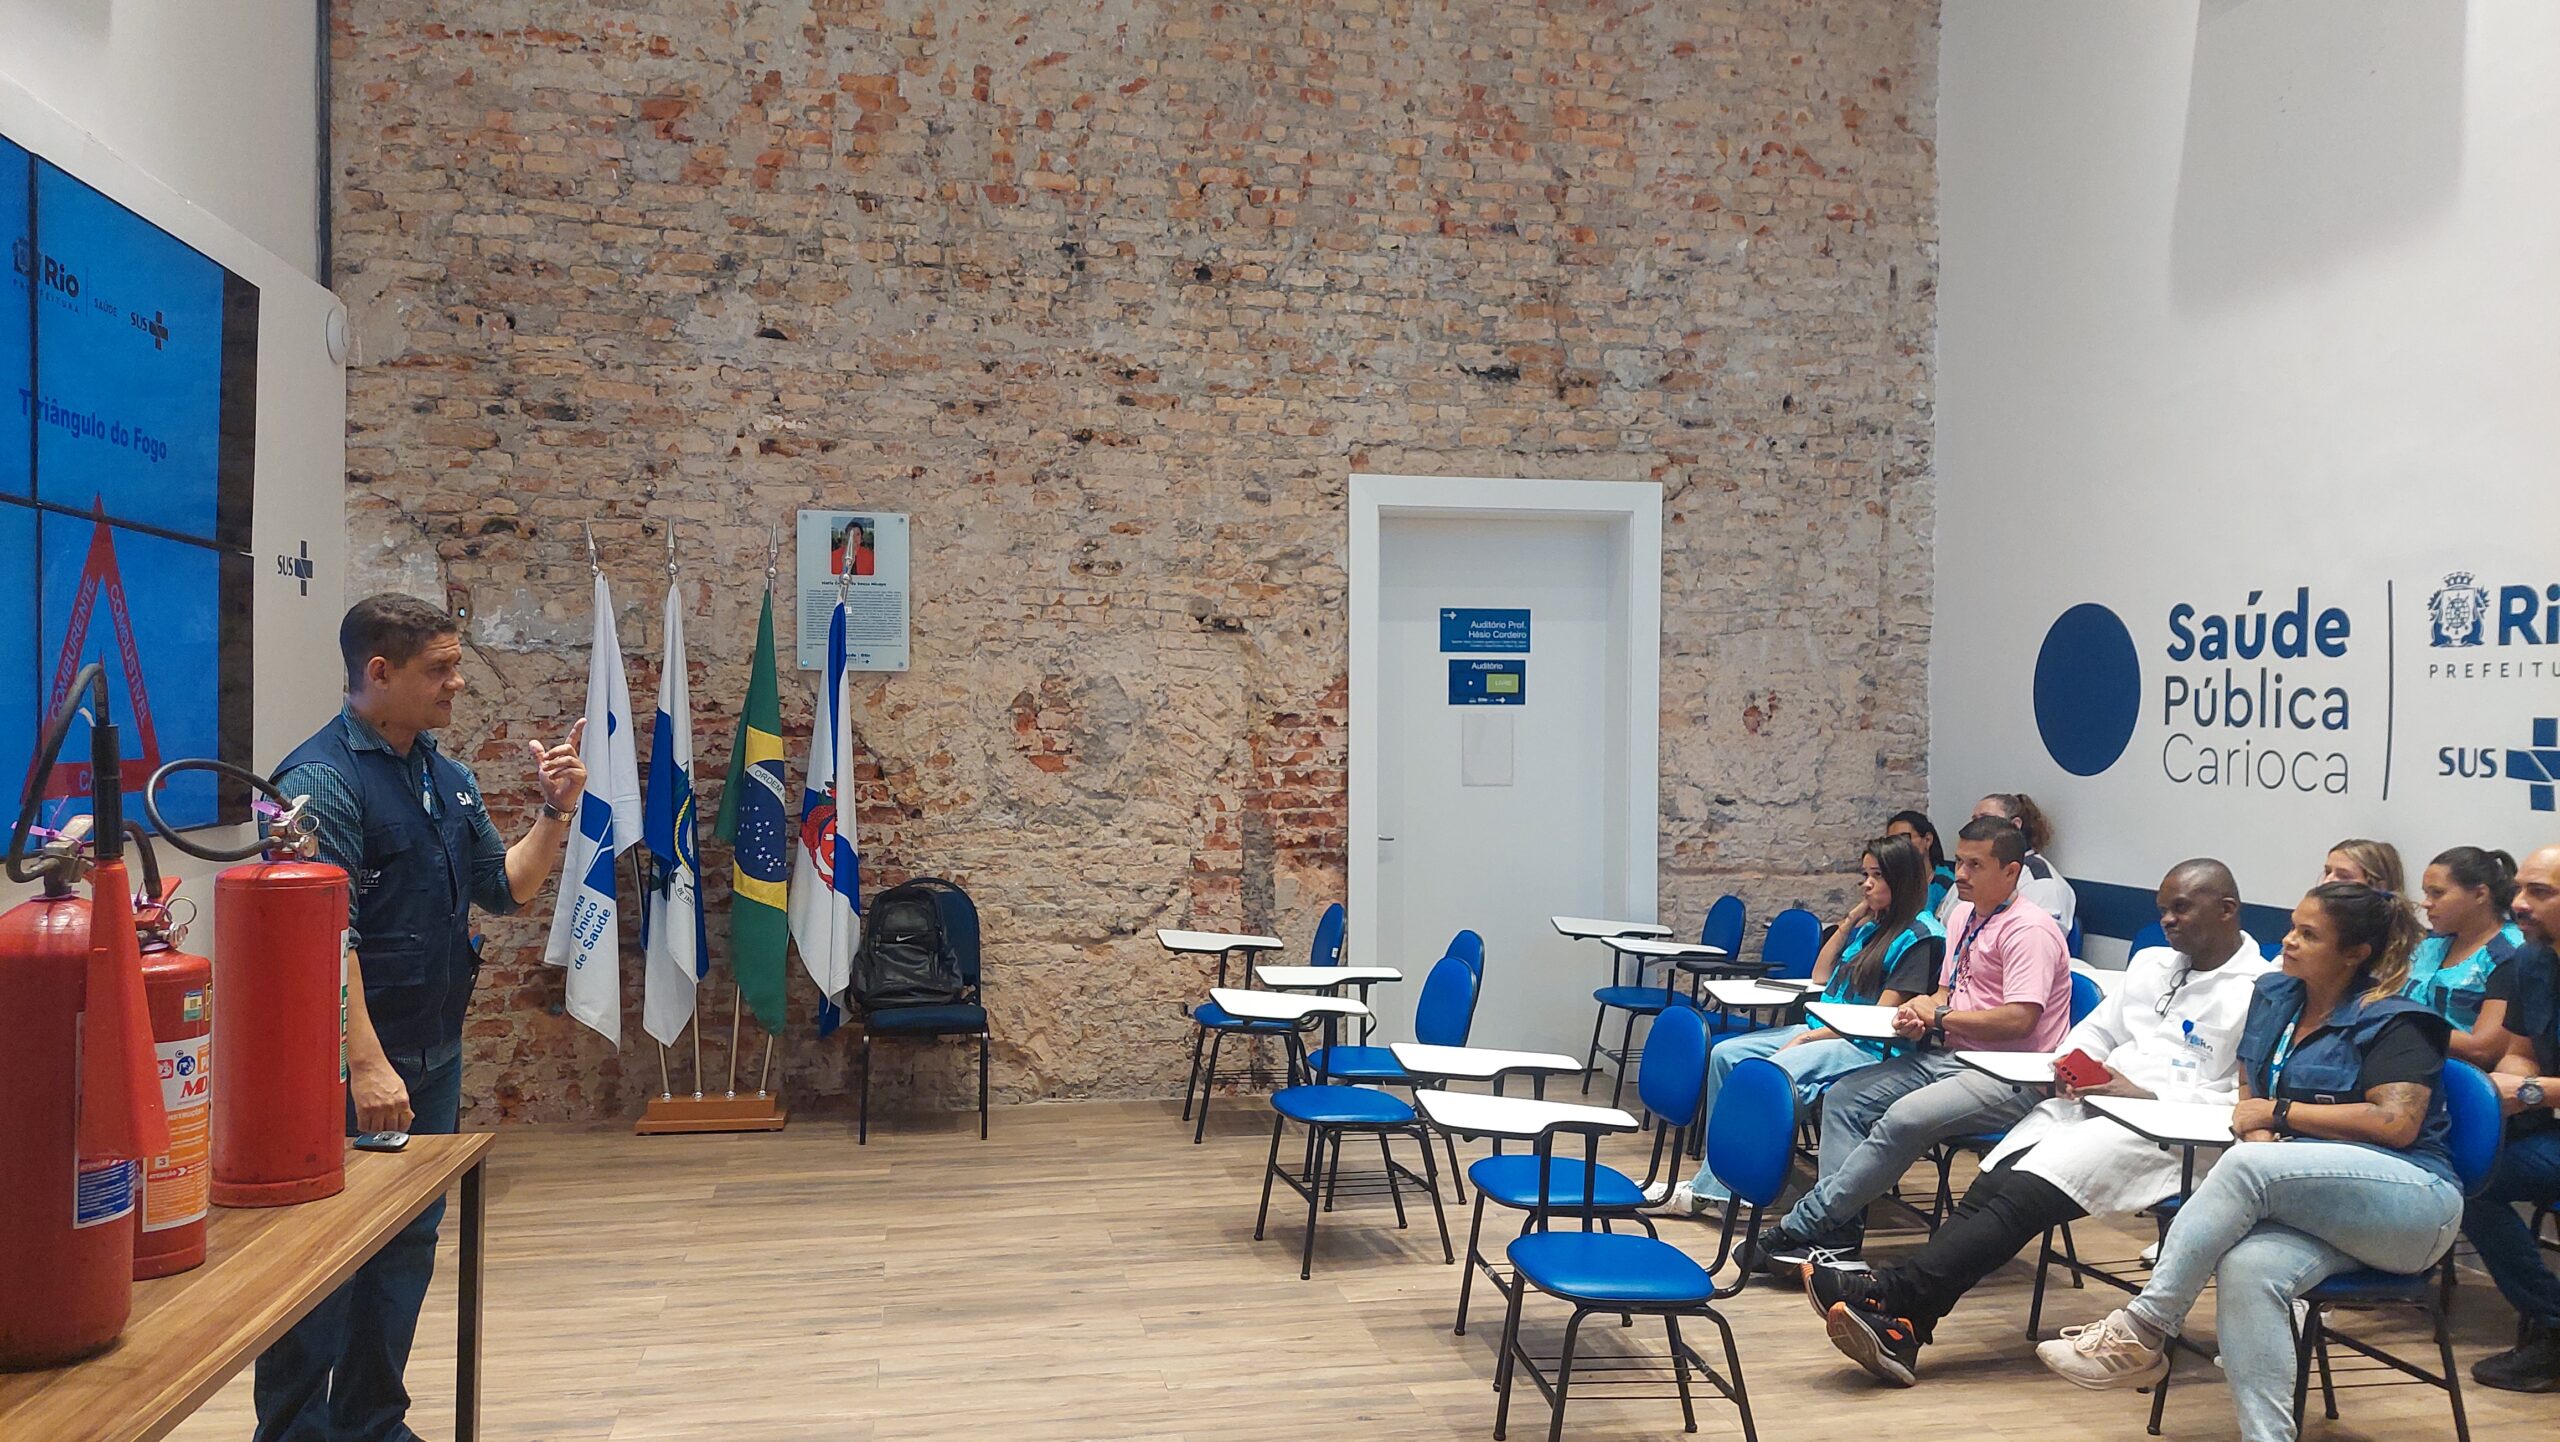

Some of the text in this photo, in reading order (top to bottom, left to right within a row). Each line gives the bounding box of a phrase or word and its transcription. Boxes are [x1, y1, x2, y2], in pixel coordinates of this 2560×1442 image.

[45, 255, 80, 298] Rio
[130, 311, 148, 332] SUS
[18, 388, 167, 463] Triângulo do Fogo
[277, 555, 294, 576] SUS
[1470, 620, 1527, 629] Auditório Prof.
[1492, 630, 1527, 639] Cordeiro
[2167, 586, 2351, 662] Saúde
[1471, 662, 1503, 670] Auditório
[2164, 667, 2350, 731] Pública
[2163, 733, 2349, 794] Carioca
[2438, 746, 2498, 779] SUS
[754, 769, 783, 792] ORDEM
[575, 909, 611, 970] de Saúde
[159, 1158, 167, 1166] 3
